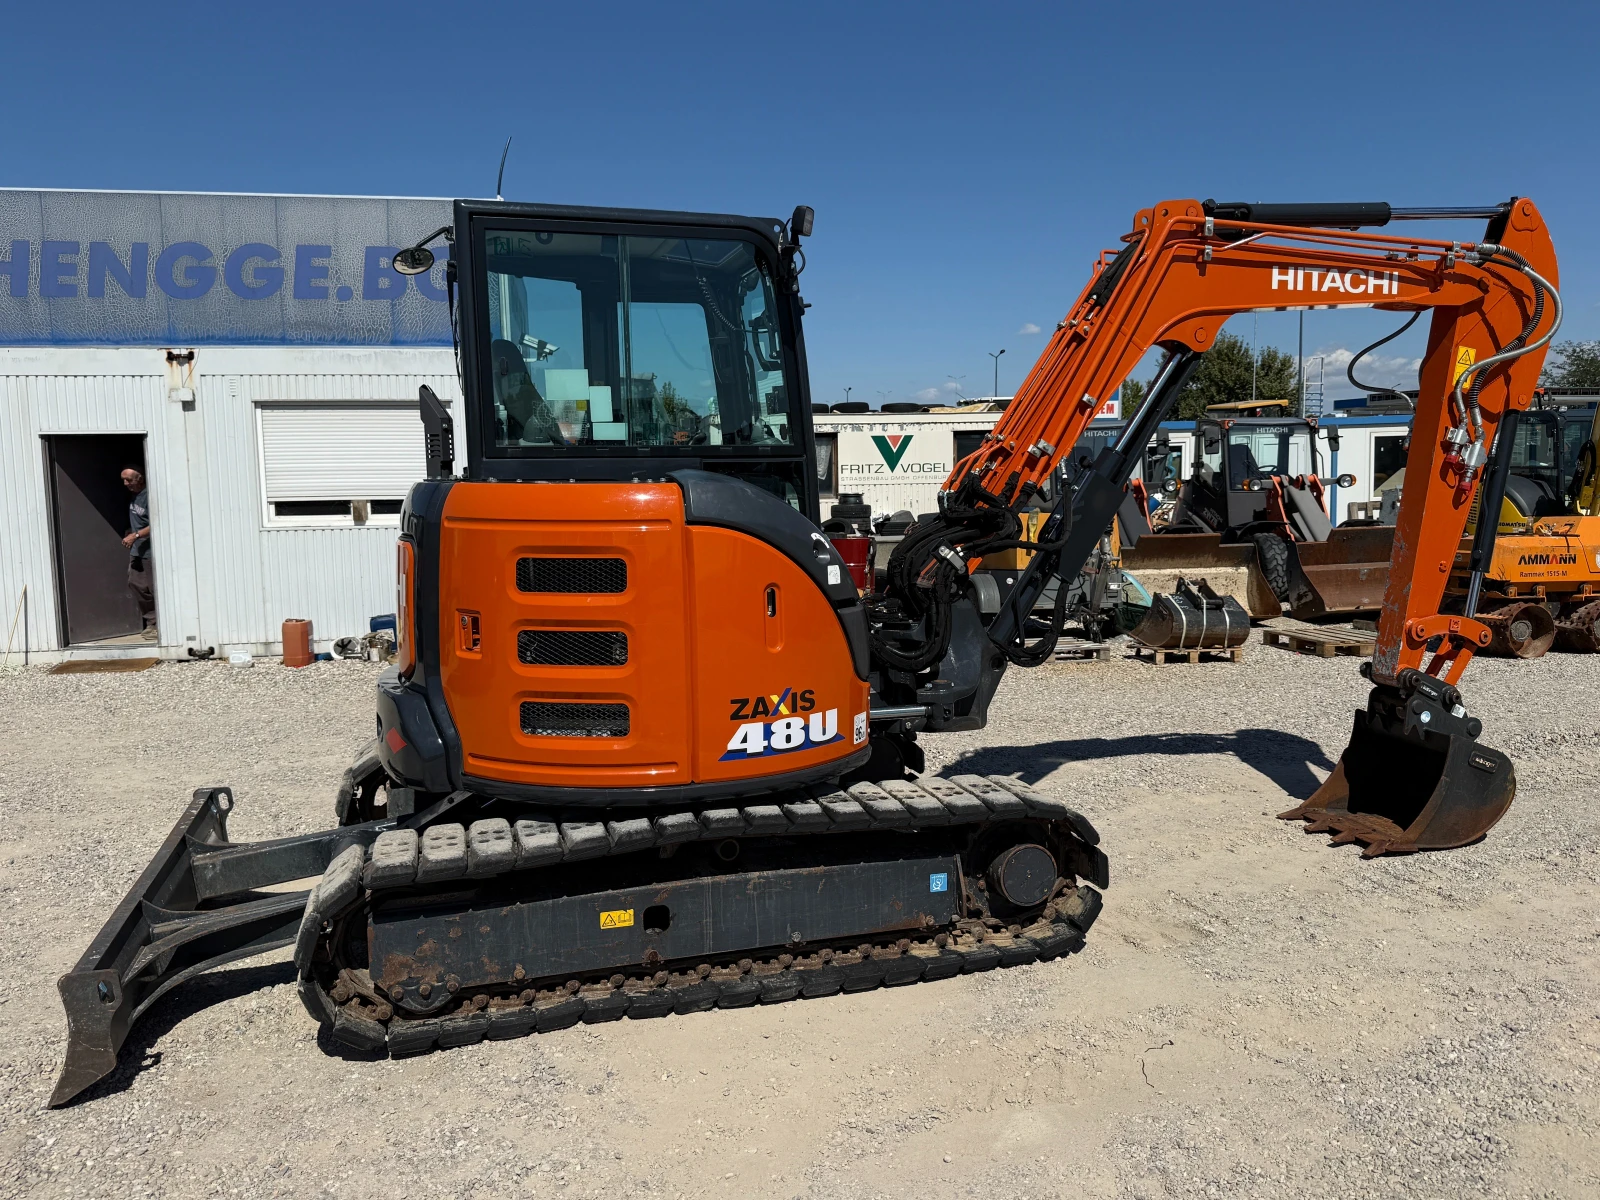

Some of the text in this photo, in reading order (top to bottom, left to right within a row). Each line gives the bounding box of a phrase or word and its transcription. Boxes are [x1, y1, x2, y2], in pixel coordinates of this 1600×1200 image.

[1271, 265, 1399, 295] HITACHI
[1084, 430, 1117, 438] HITACHI
[840, 463, 950, 475] FRITZ VOGEL
[1518, 553, 1577, 565] AMMANN
[730, 687, 816, 721] ZAXIS
[727, 708, 838, 756] 48U
